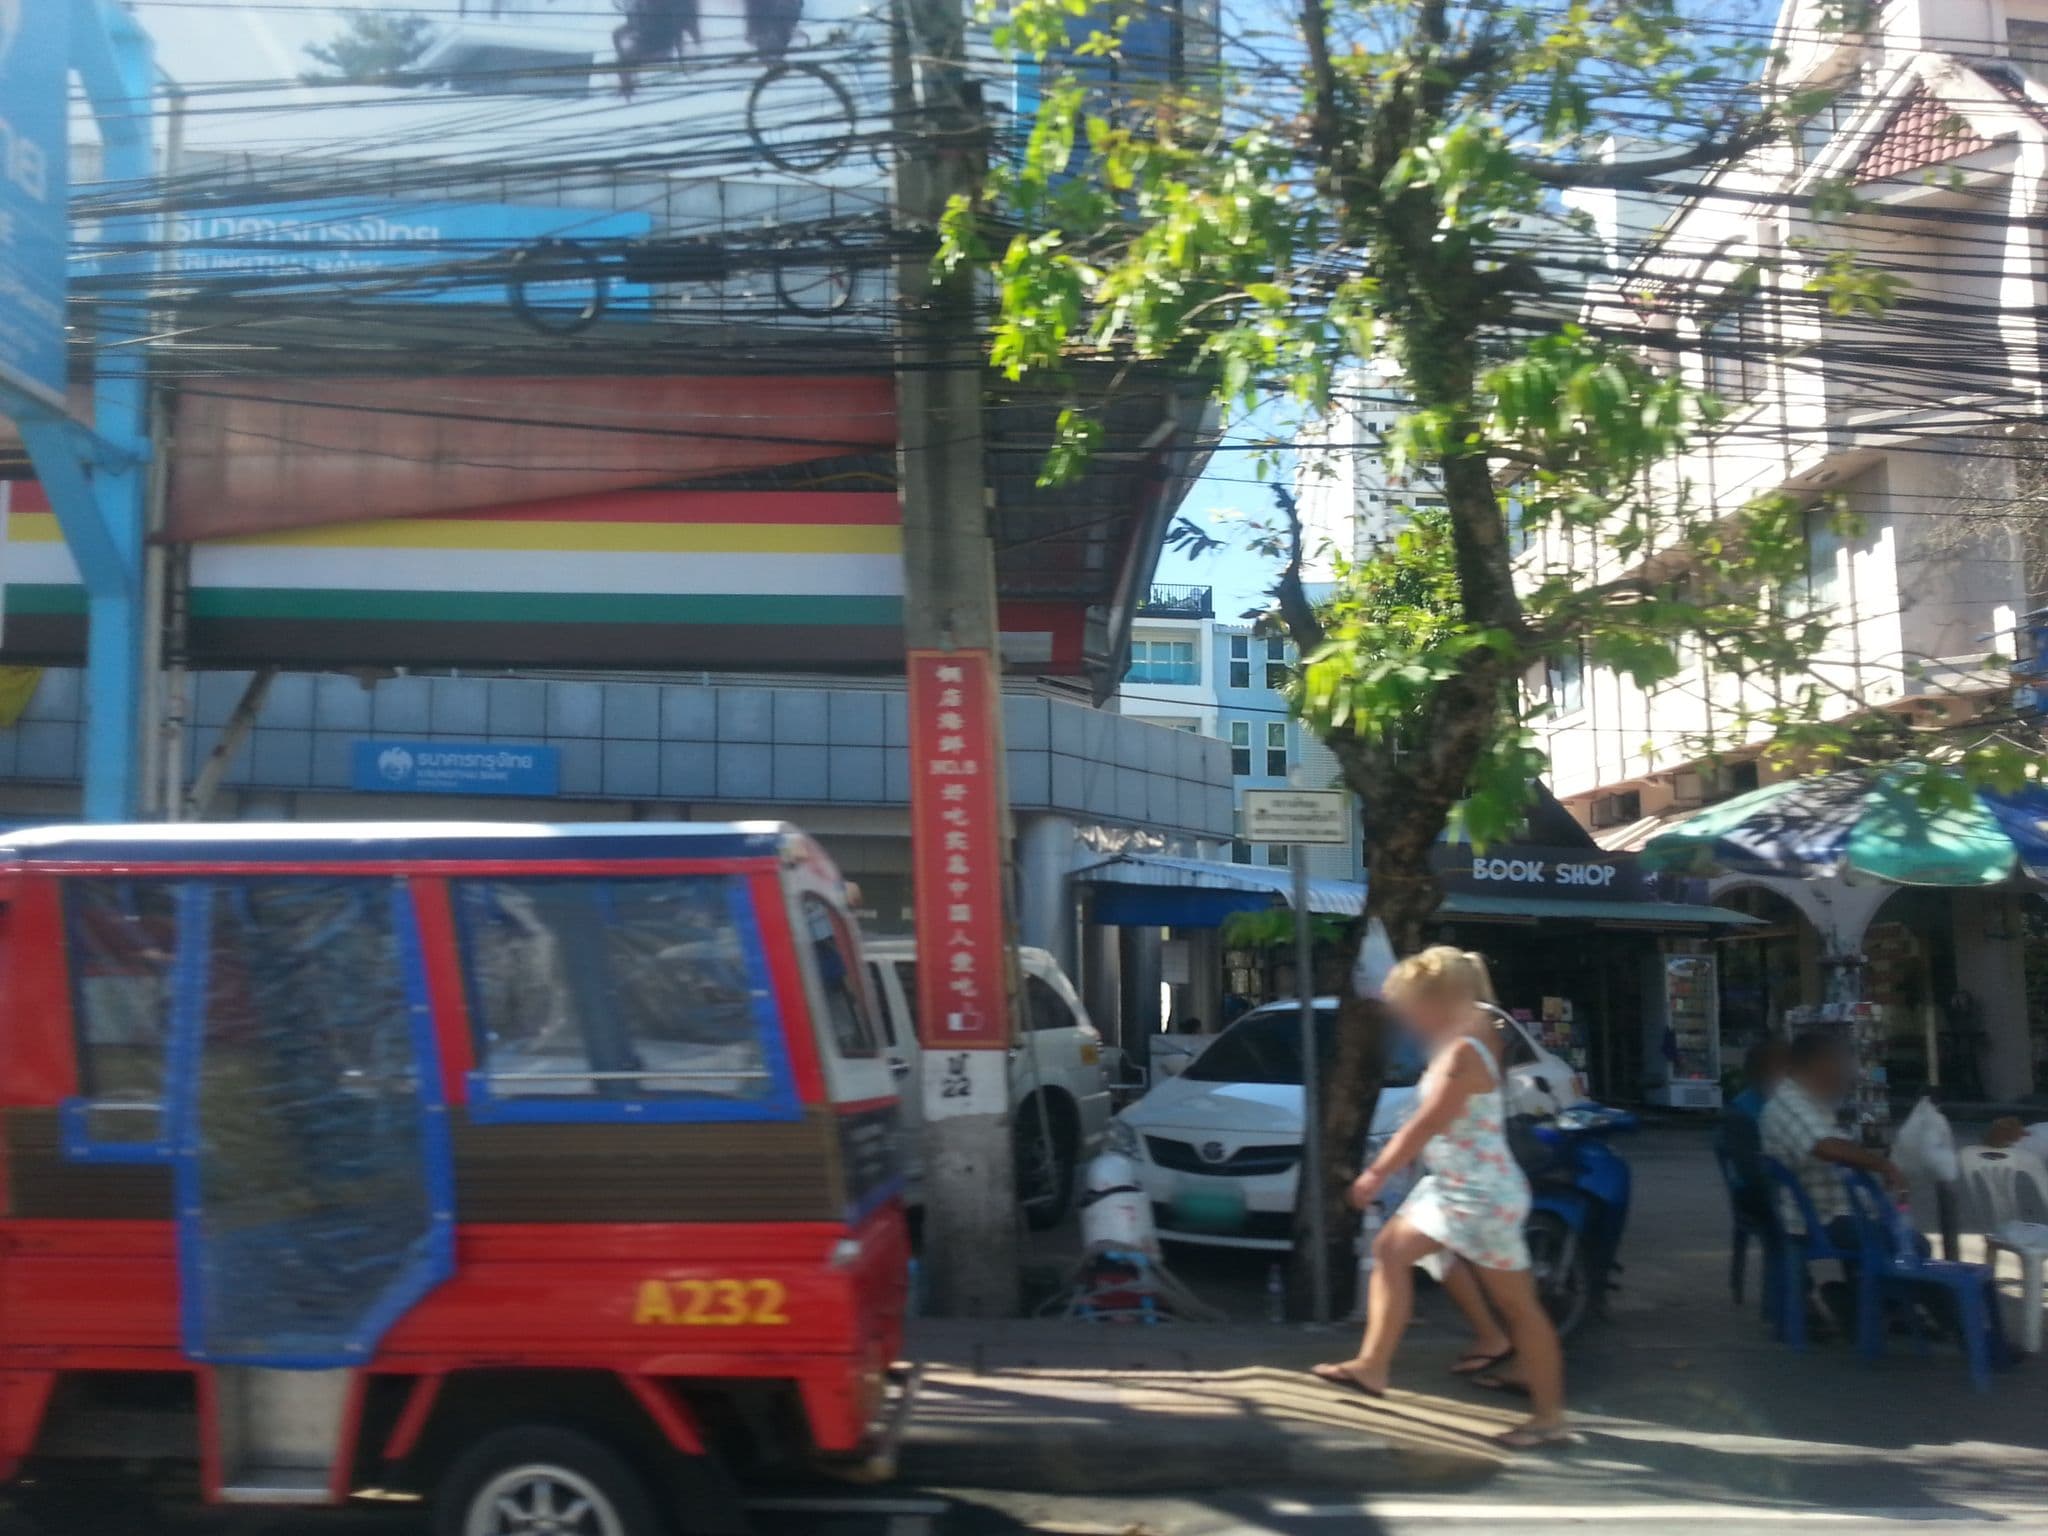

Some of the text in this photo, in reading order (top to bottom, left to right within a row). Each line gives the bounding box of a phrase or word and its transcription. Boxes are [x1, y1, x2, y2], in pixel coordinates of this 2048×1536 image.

[1472, 858, 1617, 887] BOOK SHOP
[633, 1278, 791, 1326] A232
